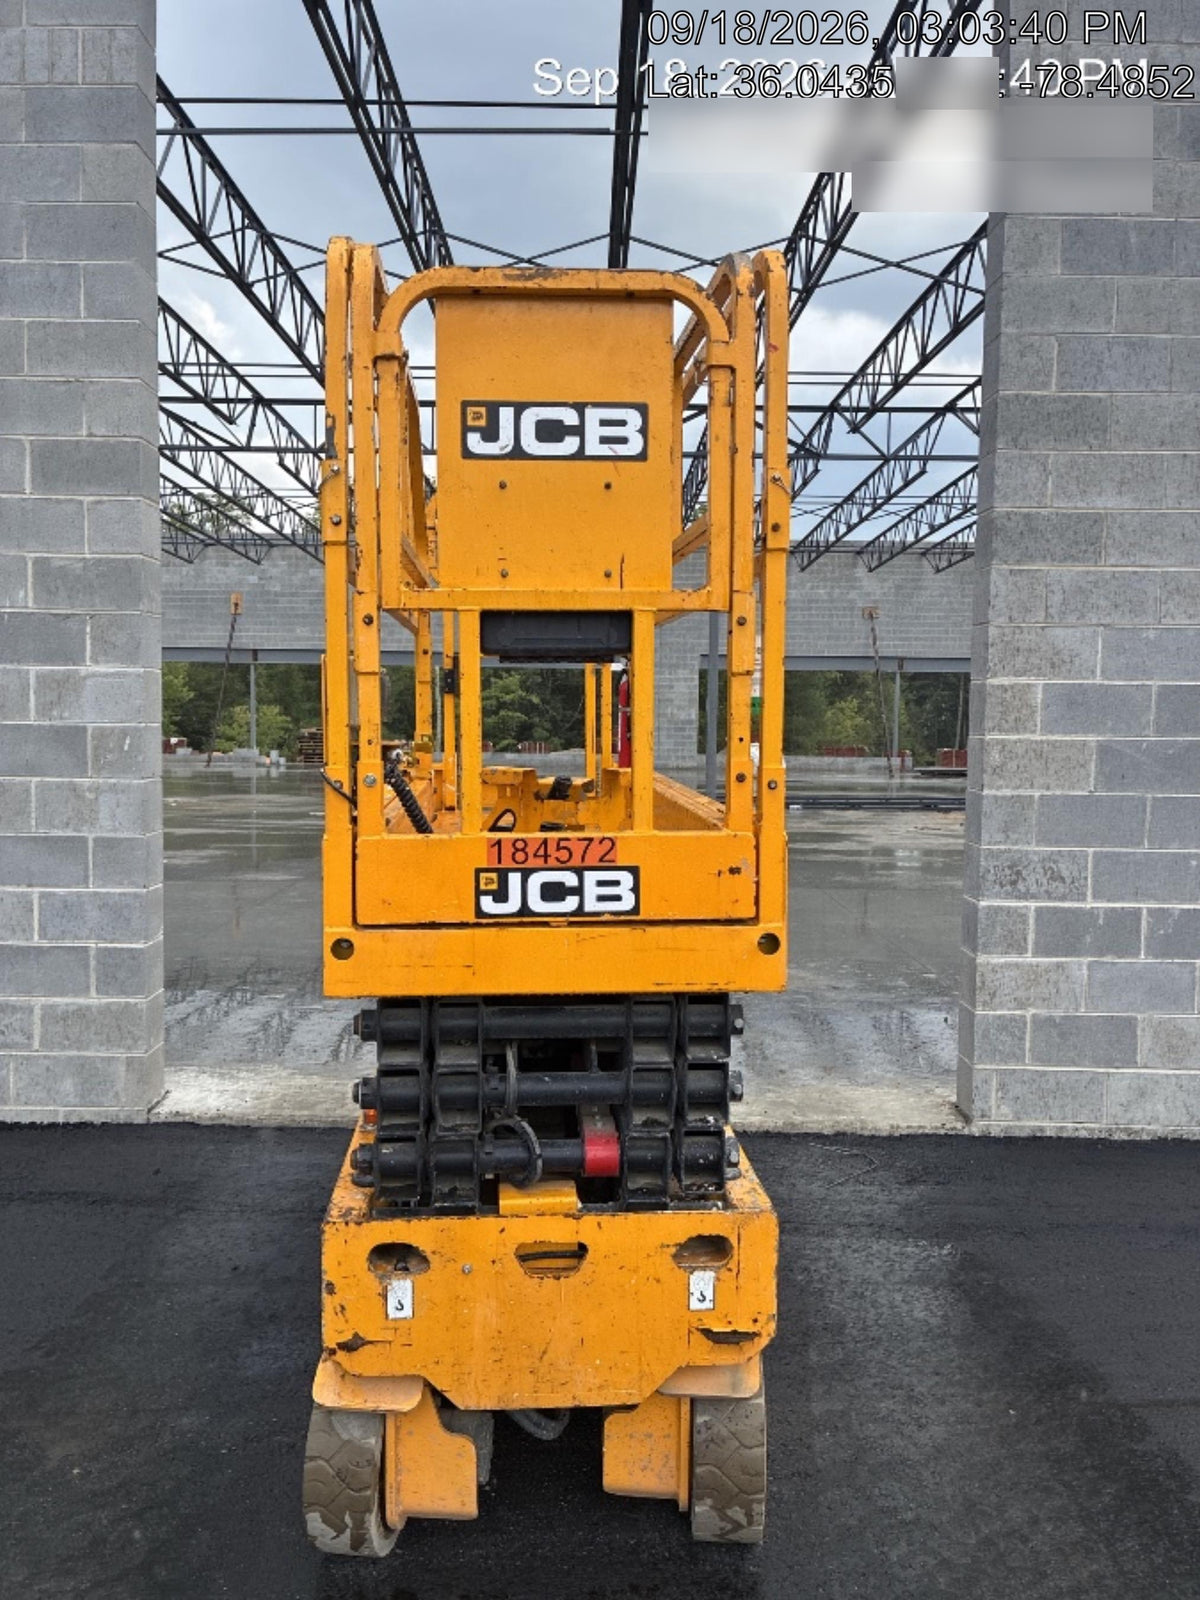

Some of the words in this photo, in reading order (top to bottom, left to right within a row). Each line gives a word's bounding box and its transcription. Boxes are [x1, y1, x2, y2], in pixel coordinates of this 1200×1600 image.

[466, 406, 644, 456] JCB
[489, 837, 617, 865] 184572
[479, 870, 636, 914] JCB
